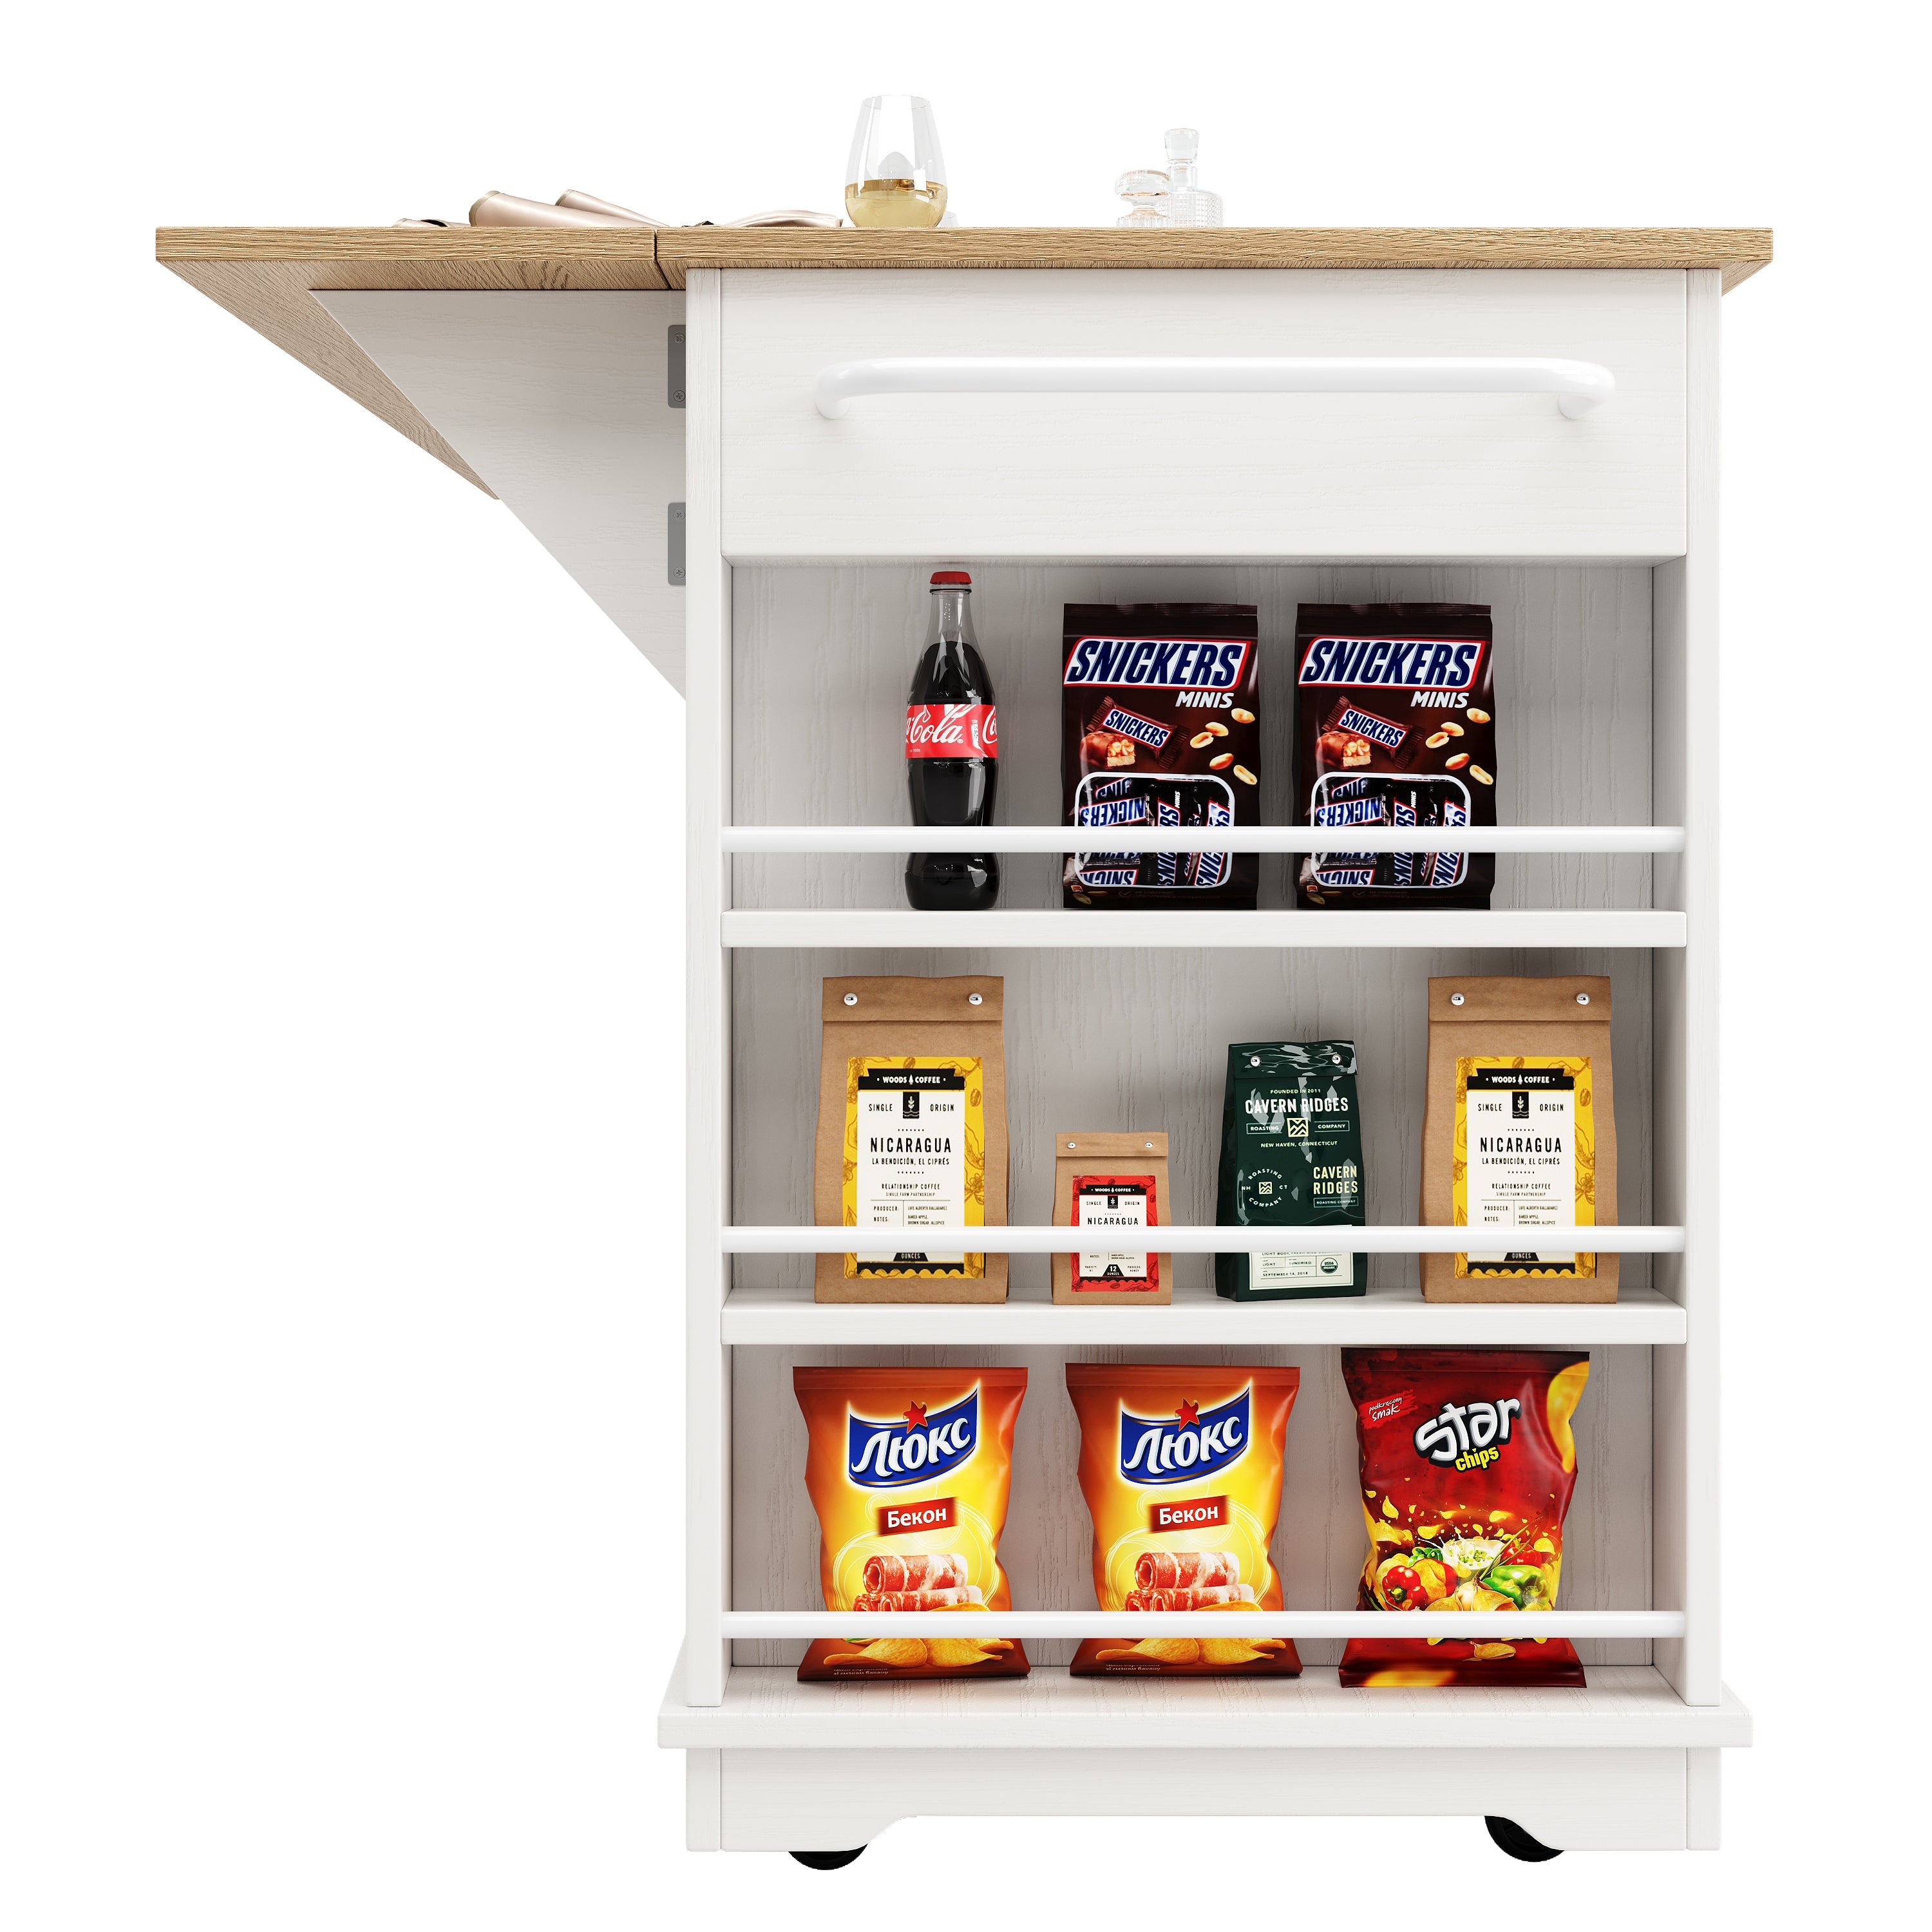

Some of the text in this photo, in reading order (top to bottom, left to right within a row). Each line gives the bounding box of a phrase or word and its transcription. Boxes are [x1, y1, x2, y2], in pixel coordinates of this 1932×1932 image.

[1066, 640, 1243, 687] SNICKERS
[1302, 640, 1478, 687] SNICKERS
[1175, 691, 1235, 708] MINIS
[1410, 691, 1470, 708] MINIS
[1105, 710, 1168, 747] SNICKERS
[1340, 710, 1404, 747] SNICKERS
[1245, 1097, 1349, 1113] CAVERN RIDGES
[871, 1137, 951, 1153] NICARAGUA
[1480, 1137, 1562, 1153] NICARAGUA
[882, 1157, 916, 1166] BENDICIÓN,
[1492, 1157, 1526, 1166] BENDICIÓN,
[1248, 1168, 1282, 1179] ROASTING
[1313, 1165, 1357, 1179] CAVERN
[1313, 1180, 1358, 1195] RIDGES
[1249, 1197, 1282, 1207] COMPANY
[1368, 1397, 1402, 1415] podkręcony
[1372, 1403, 1400, 1421] smak
[851, 1417, 971, 1477] Люкс
[1123, 1417, 1242, 1473] Люкс
[1455, 1446, 1499, 1471] chips
[887, 1508, 947, 1528] Бекон
[1159, 1505, 1218, 1525] Бекон
